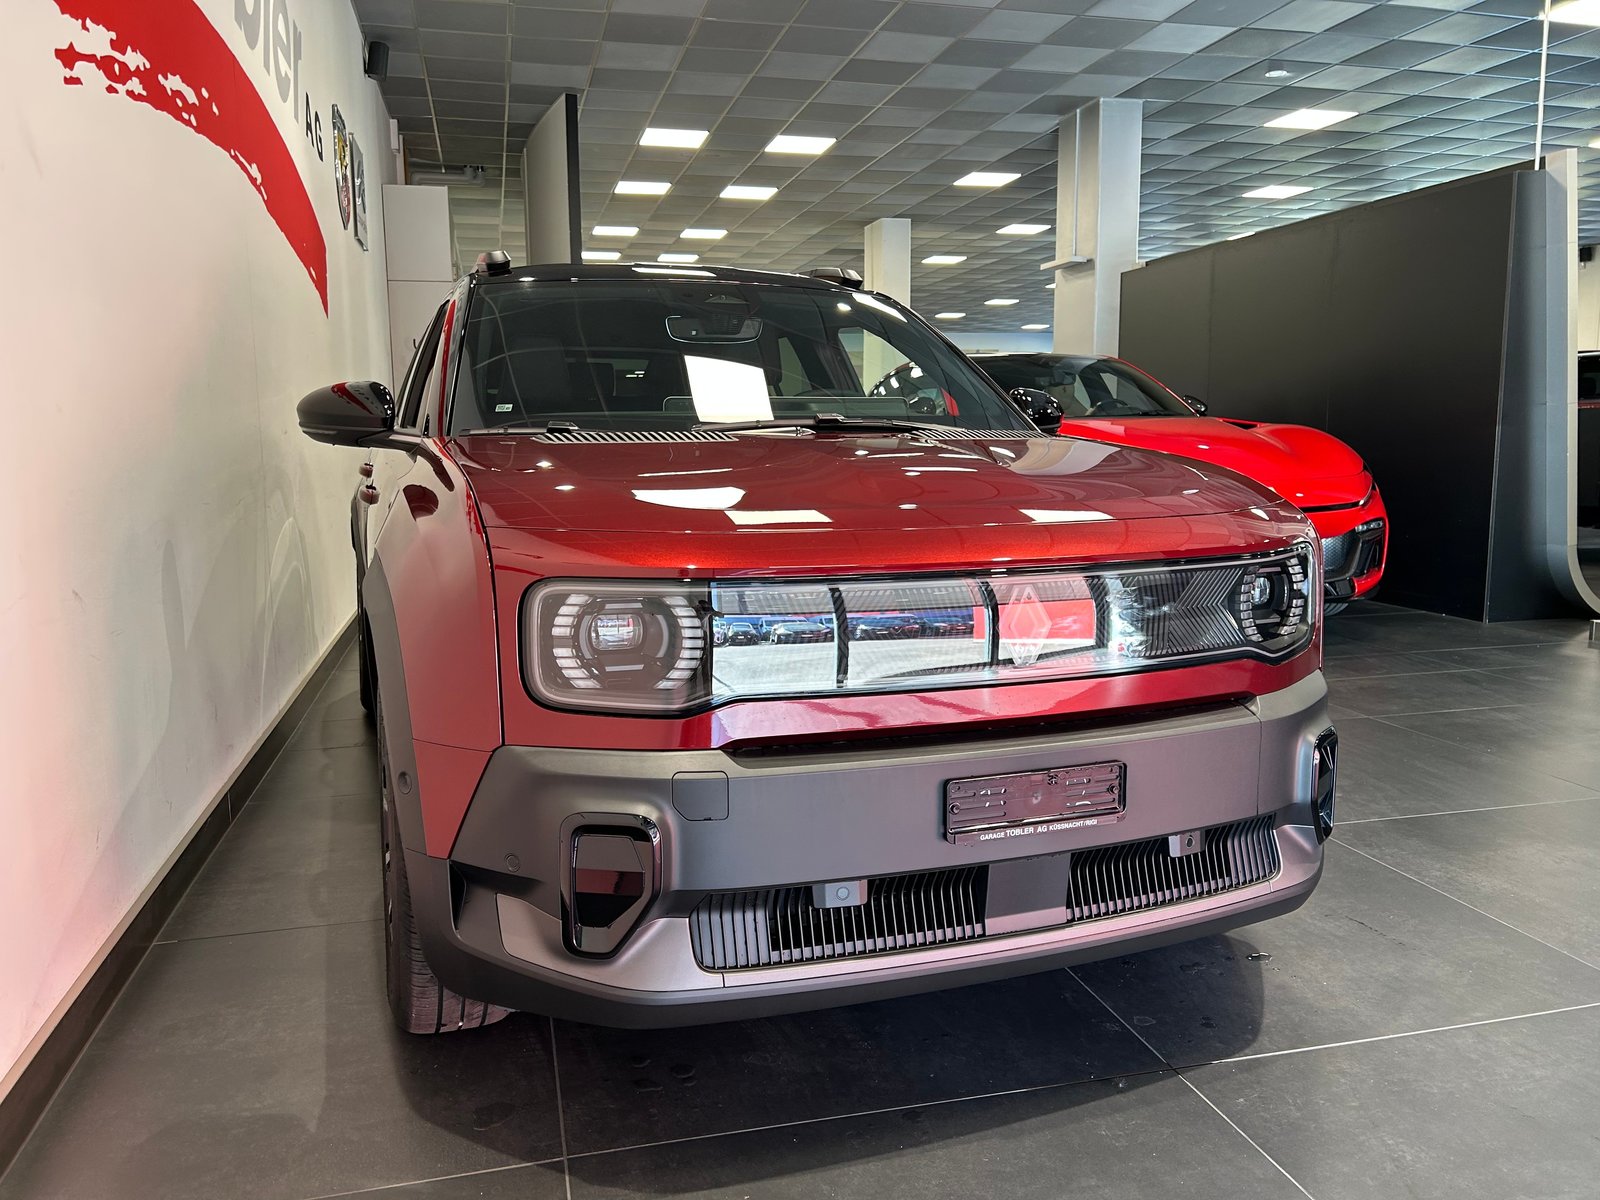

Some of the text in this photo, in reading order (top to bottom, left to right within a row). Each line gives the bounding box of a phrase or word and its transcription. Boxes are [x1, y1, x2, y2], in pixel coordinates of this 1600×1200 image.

[306, 92, 324, 162] AG
[980, 831, 1005, 841] GARAGE
[1006, 827, 1034, 837] TOBLER
[1037, 825, 1047, 833] AG
